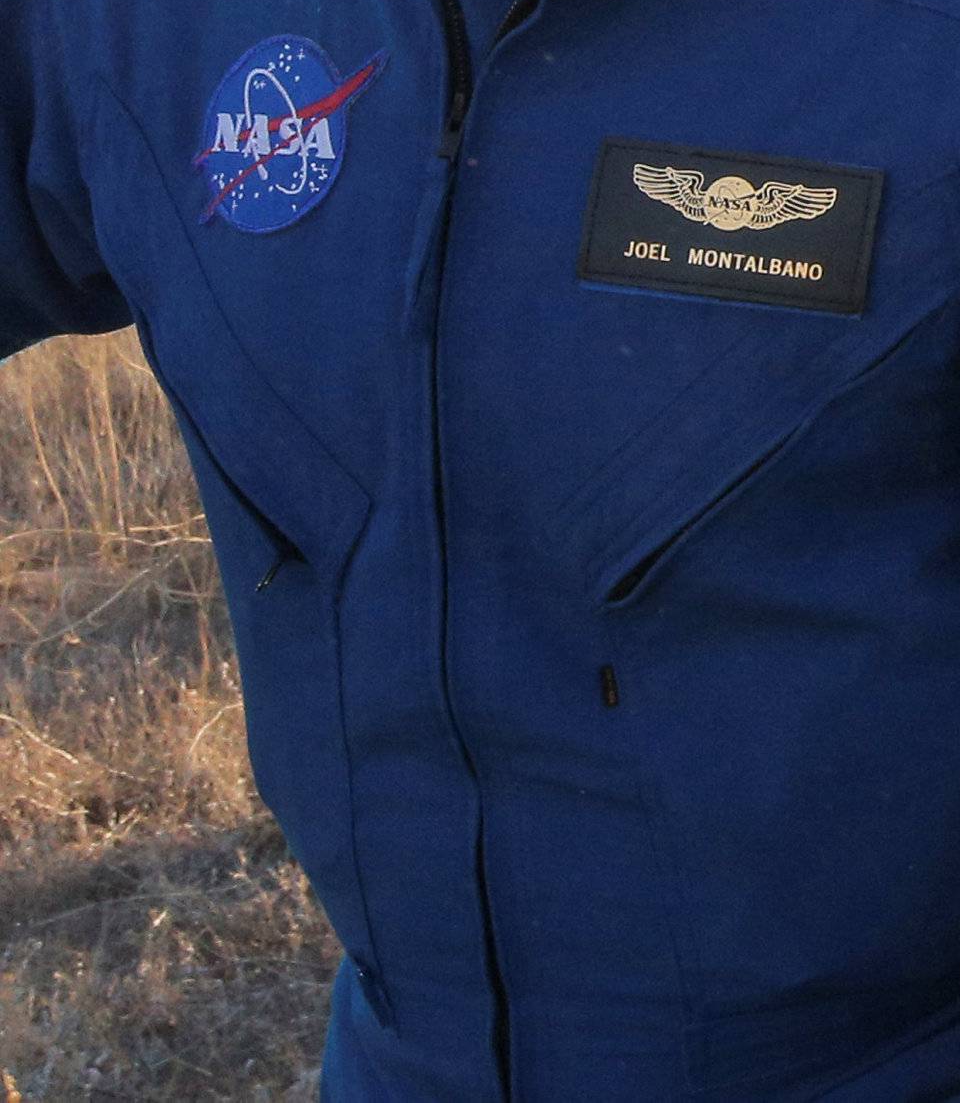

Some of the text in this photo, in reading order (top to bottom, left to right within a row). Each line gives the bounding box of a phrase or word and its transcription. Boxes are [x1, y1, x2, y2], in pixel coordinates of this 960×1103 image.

[212, 113, 336, 159] NASA
[708, 195, 751, 212] NASA
[624, 241, 823, 281] JOEL MONTALBANO
